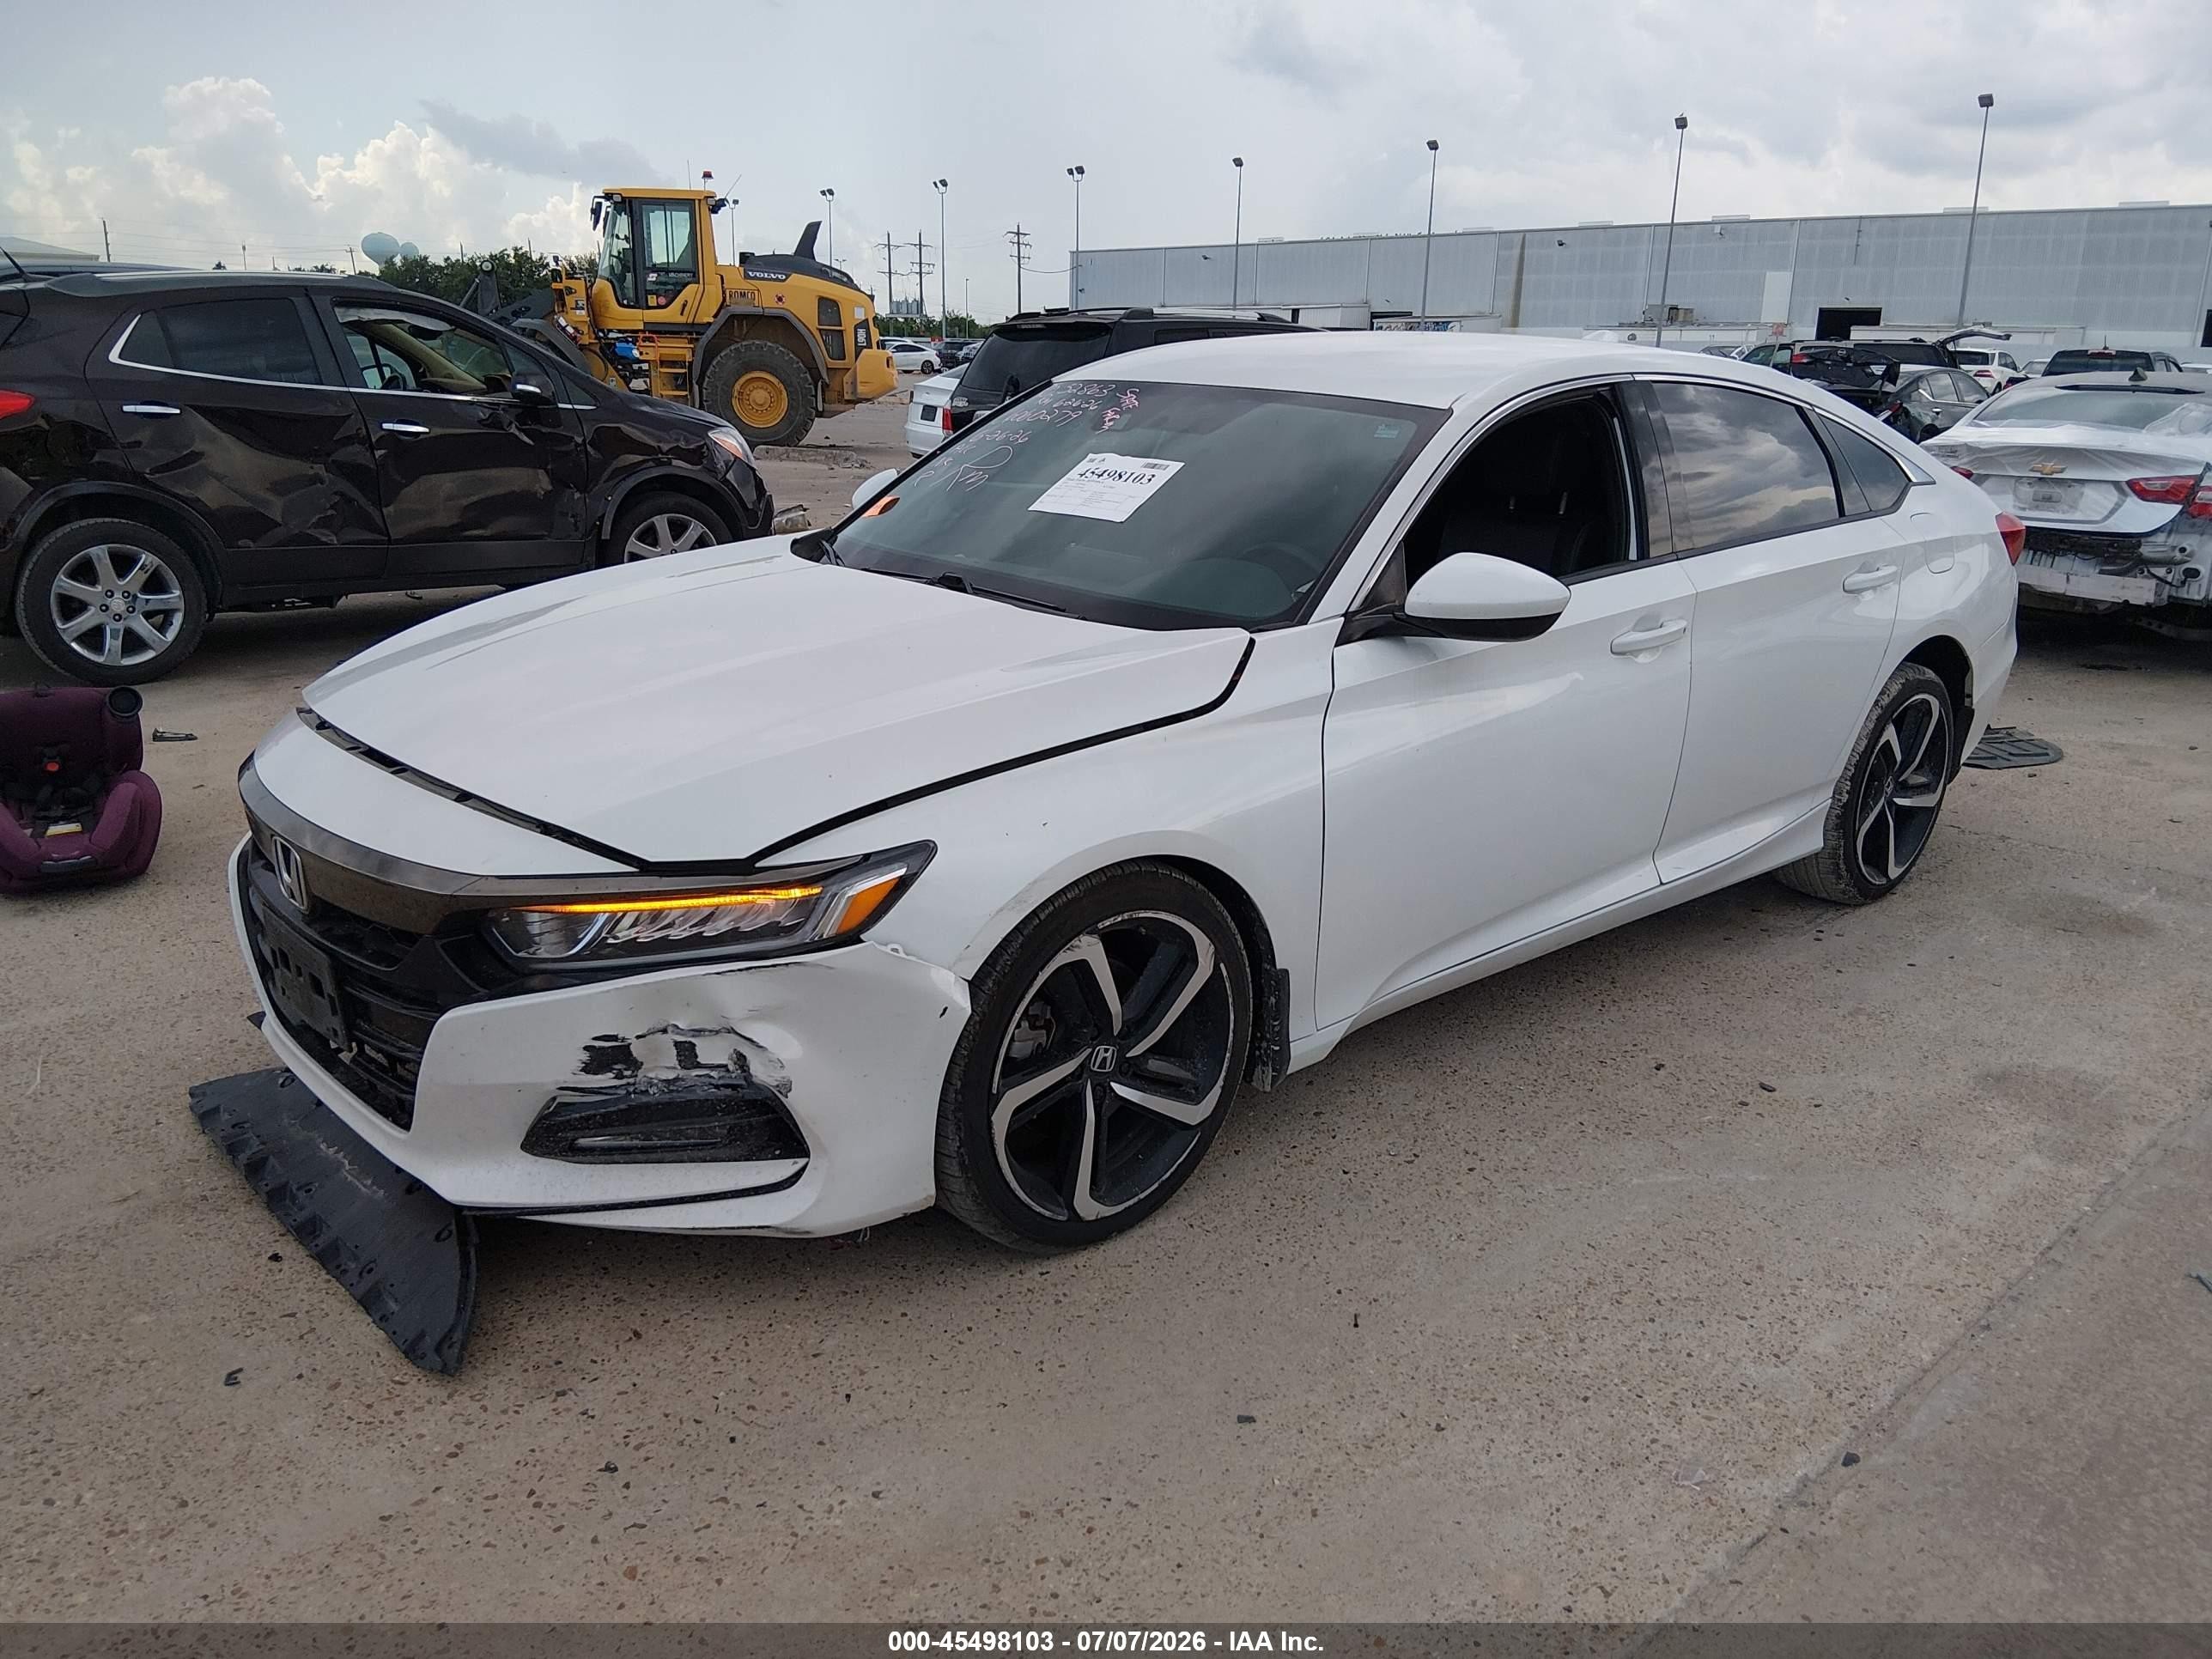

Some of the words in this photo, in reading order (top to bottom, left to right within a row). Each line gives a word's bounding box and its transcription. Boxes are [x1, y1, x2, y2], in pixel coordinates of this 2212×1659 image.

[747, 270, 787, 280] VOLVO
[857, 328, 867, 346] L90H
[1078, 467, 1156, 486] 45498103
